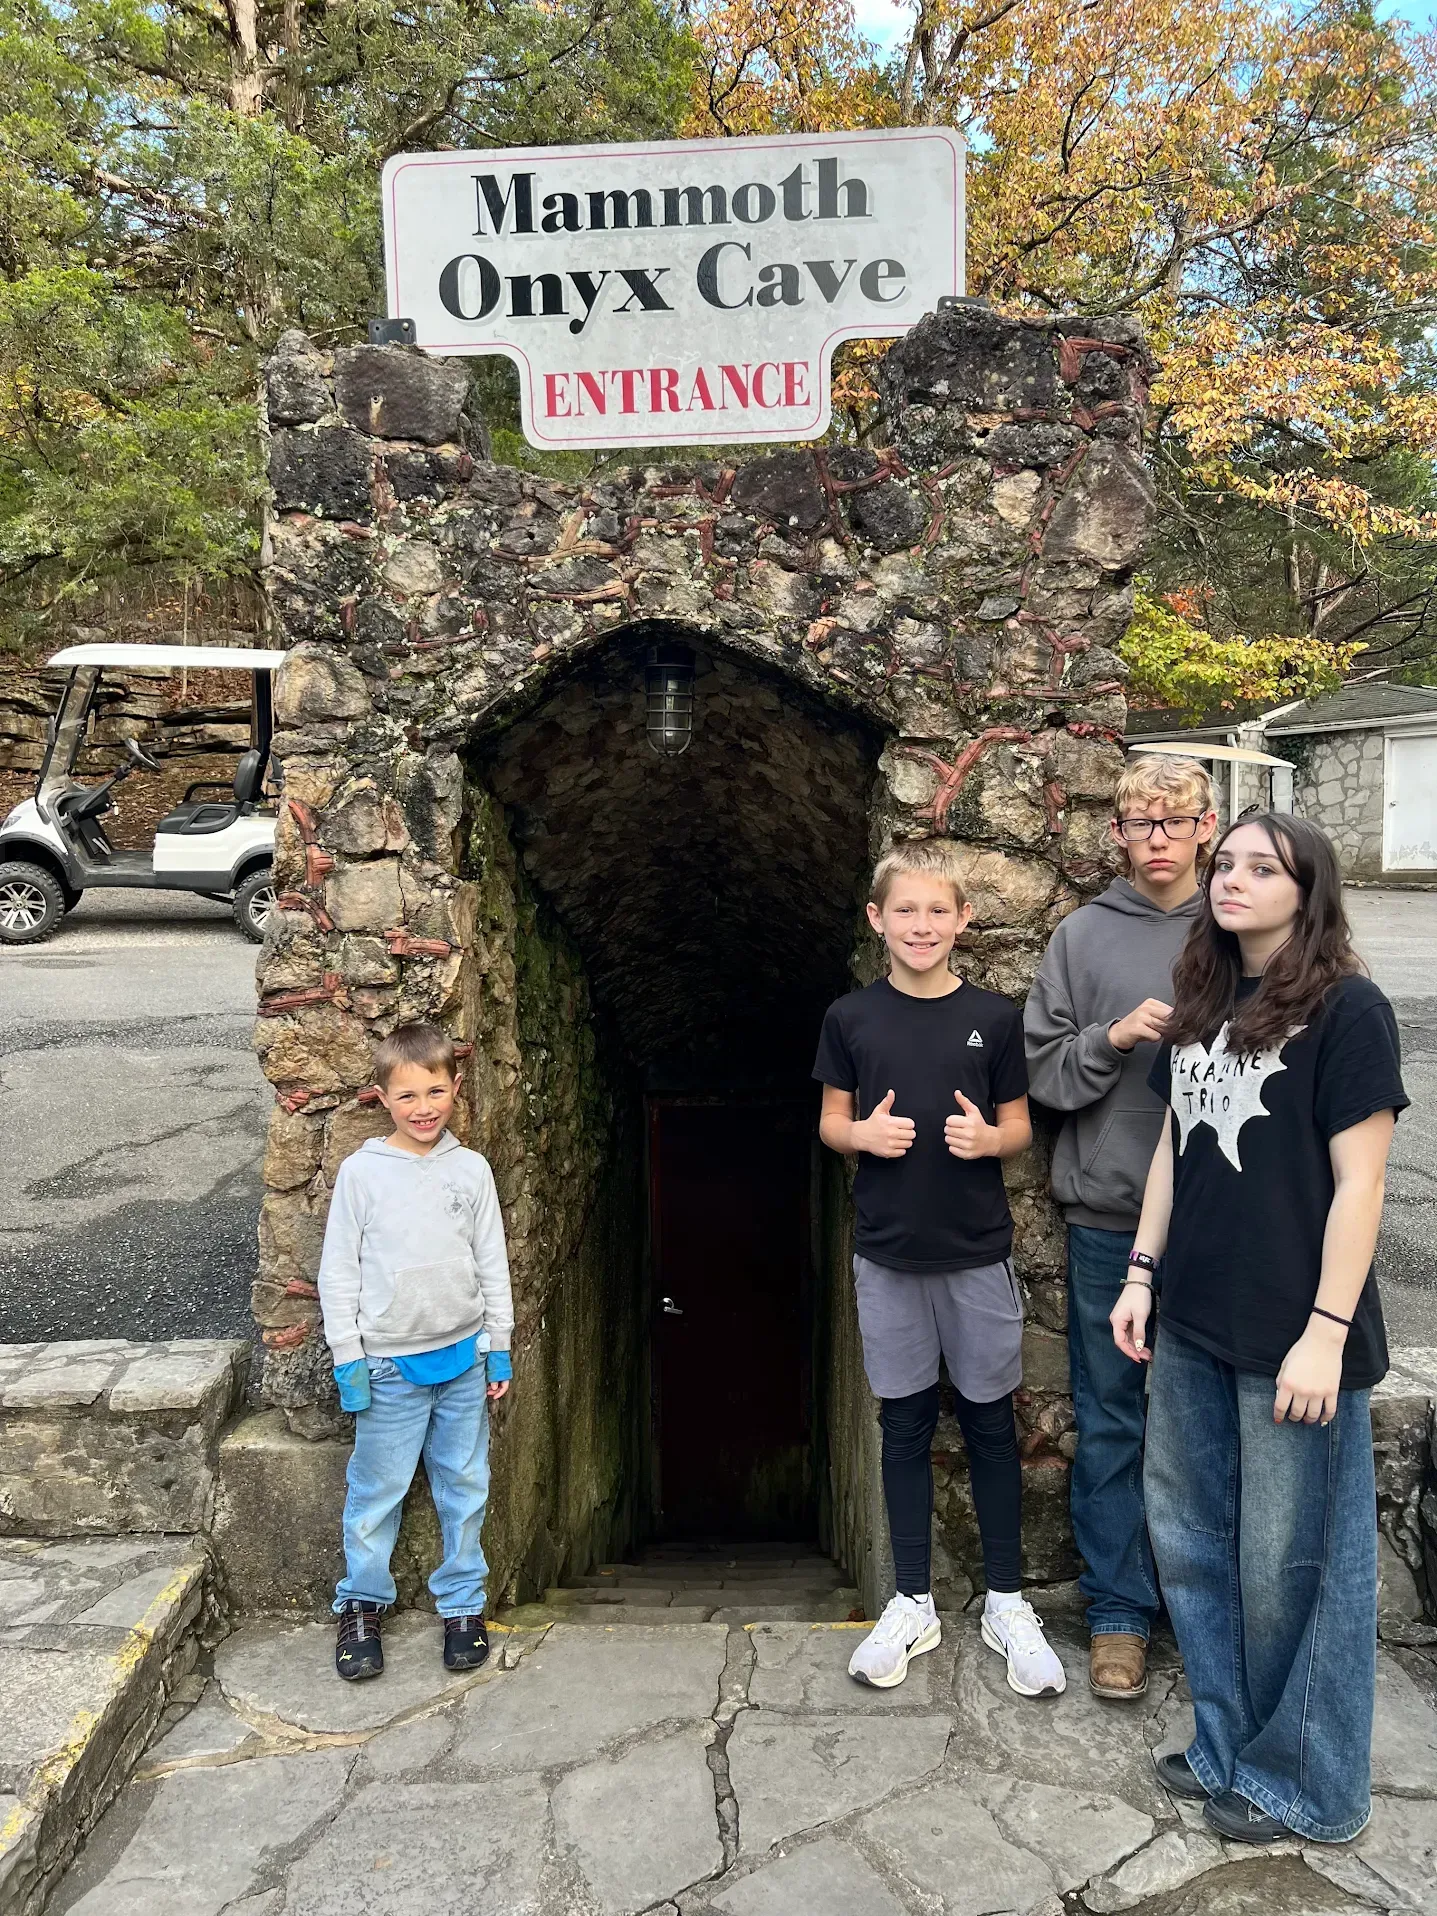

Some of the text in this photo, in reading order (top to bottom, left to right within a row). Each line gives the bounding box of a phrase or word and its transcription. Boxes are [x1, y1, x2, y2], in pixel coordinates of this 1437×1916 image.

[471, 157, 873, 237] Mammoth
[438, 241, 907, 334] Onyx Cave
[543, 361, 811, 419] ENTRANCE
[1182, 1088, 1230, 1115] TRIO
